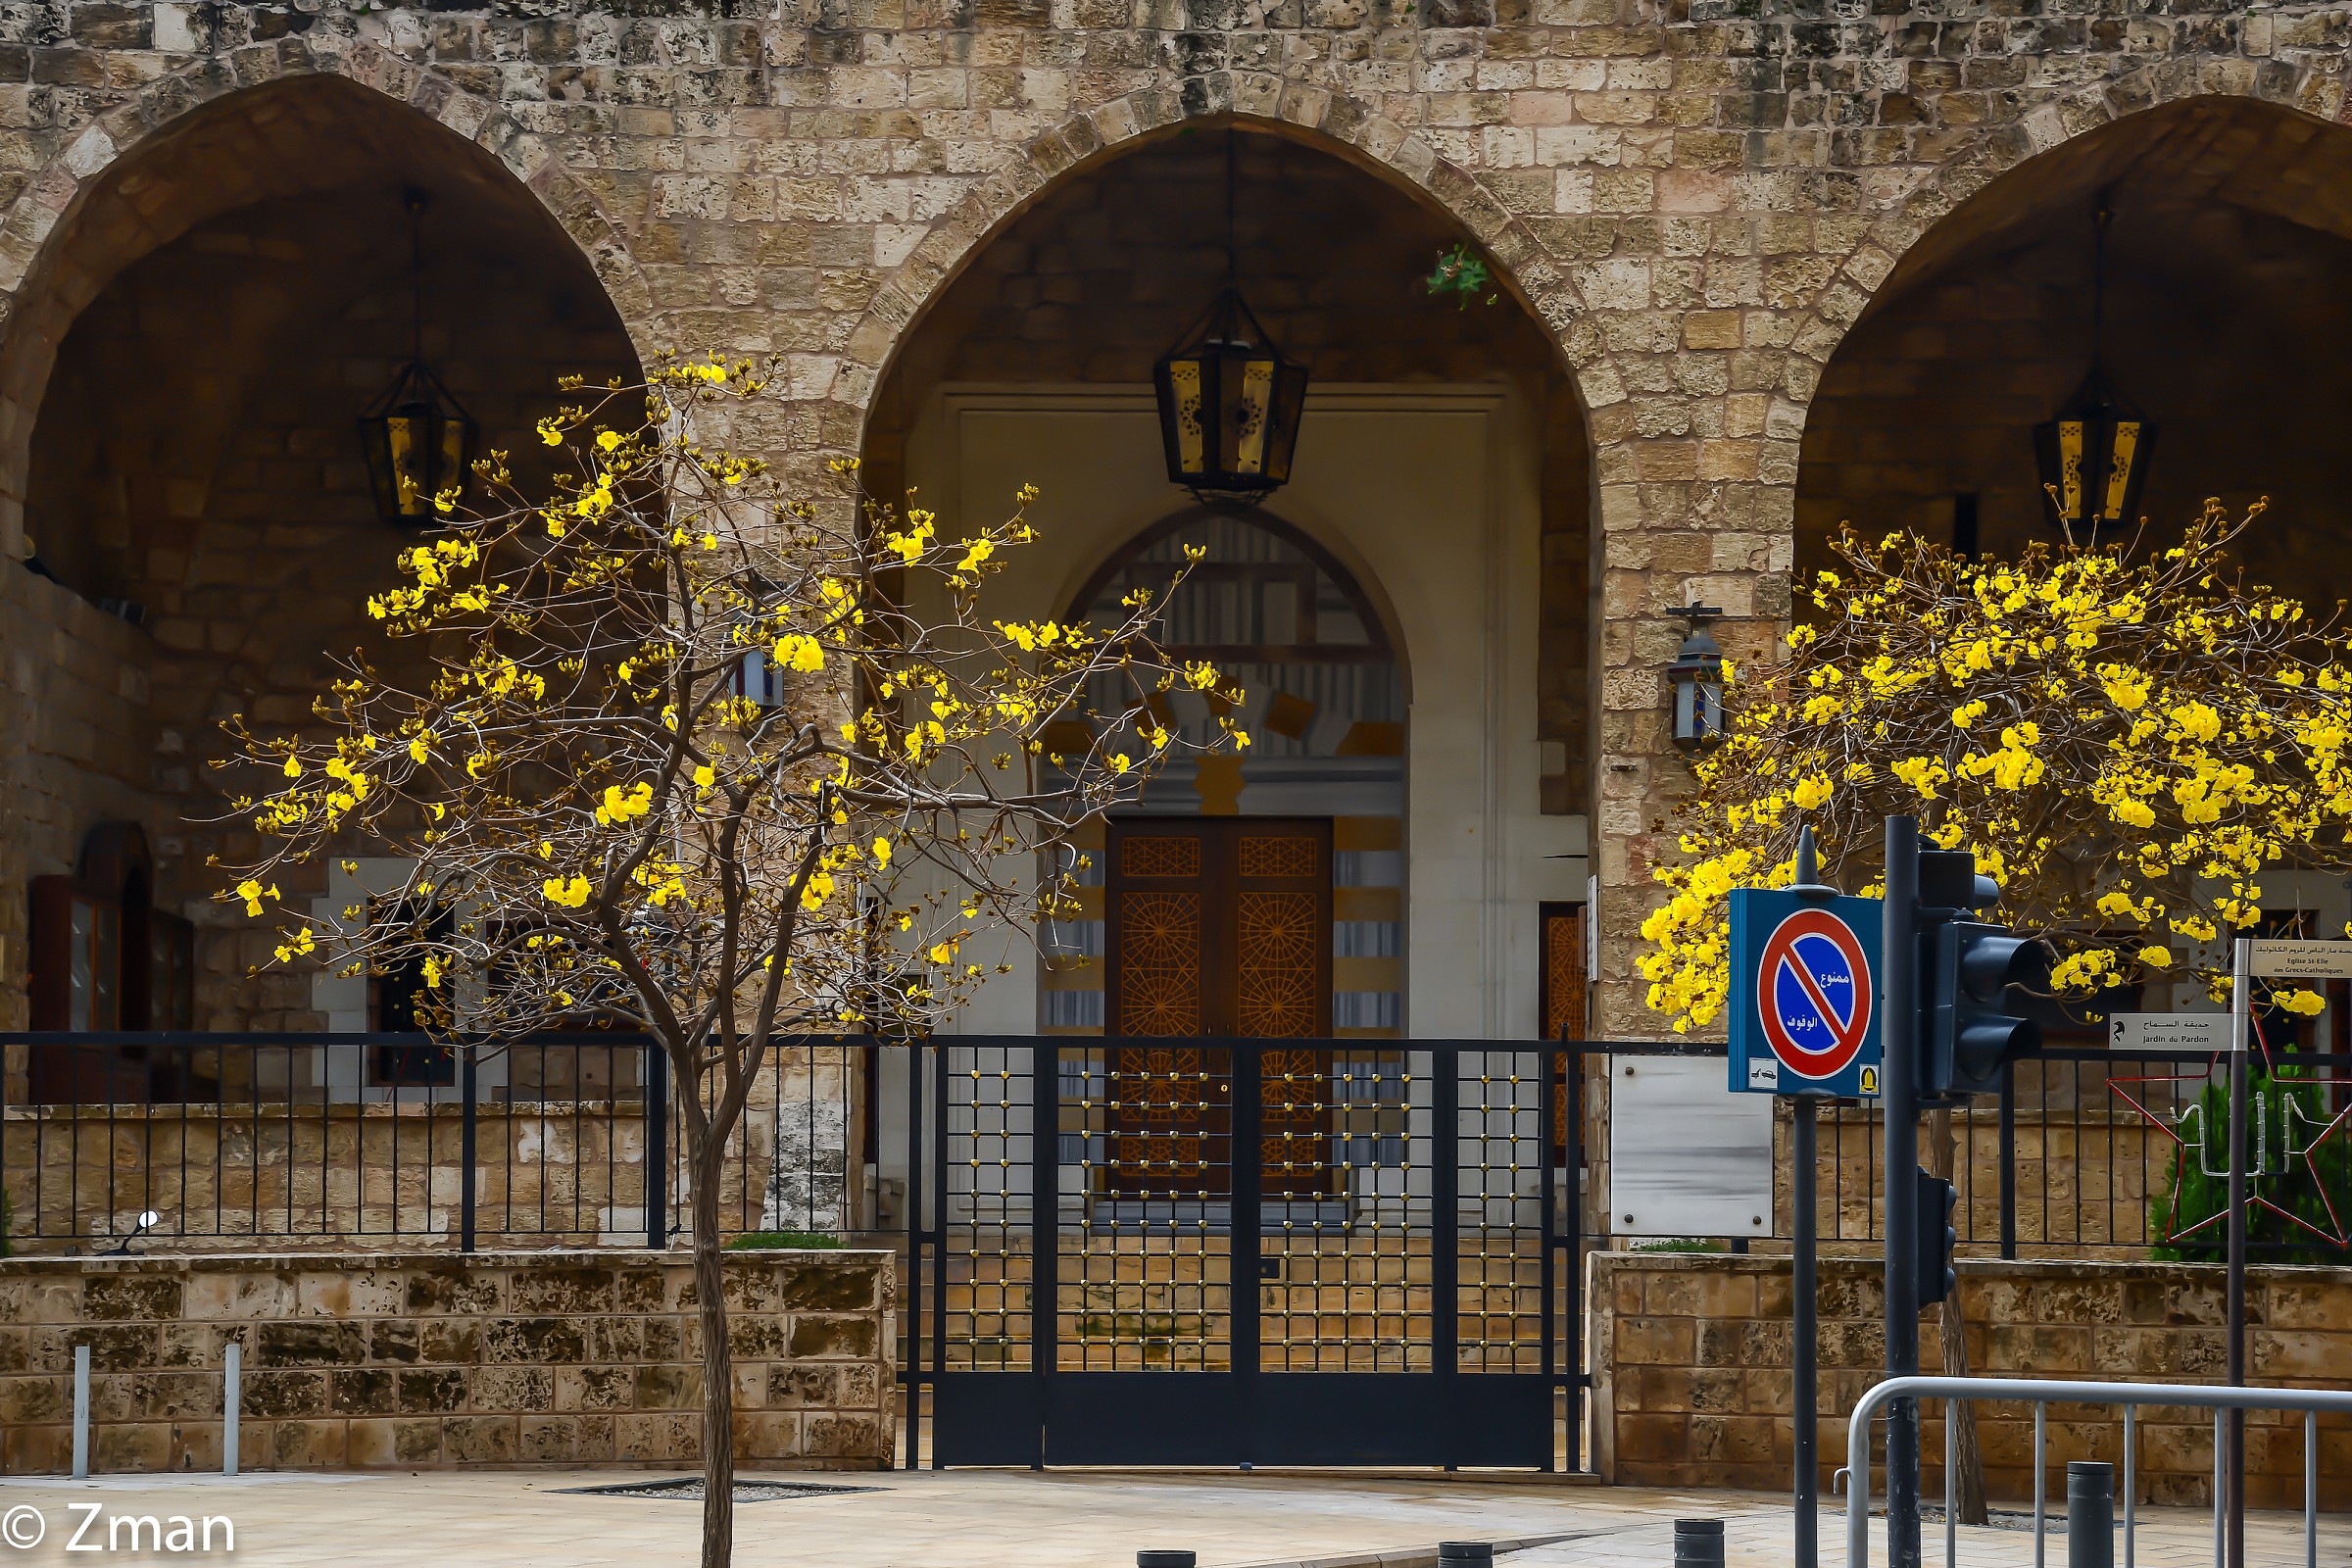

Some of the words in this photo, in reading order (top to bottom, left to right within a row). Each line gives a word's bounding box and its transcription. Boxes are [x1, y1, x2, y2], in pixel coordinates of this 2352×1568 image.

[1820, 971, 1850, 989] ممنوع
[1787, 1014, 1818, 1032] الوقوف
[2183, 1020, 2210, 1029] حديقة
[2142, 1035, 2166, 1044] Jardin
